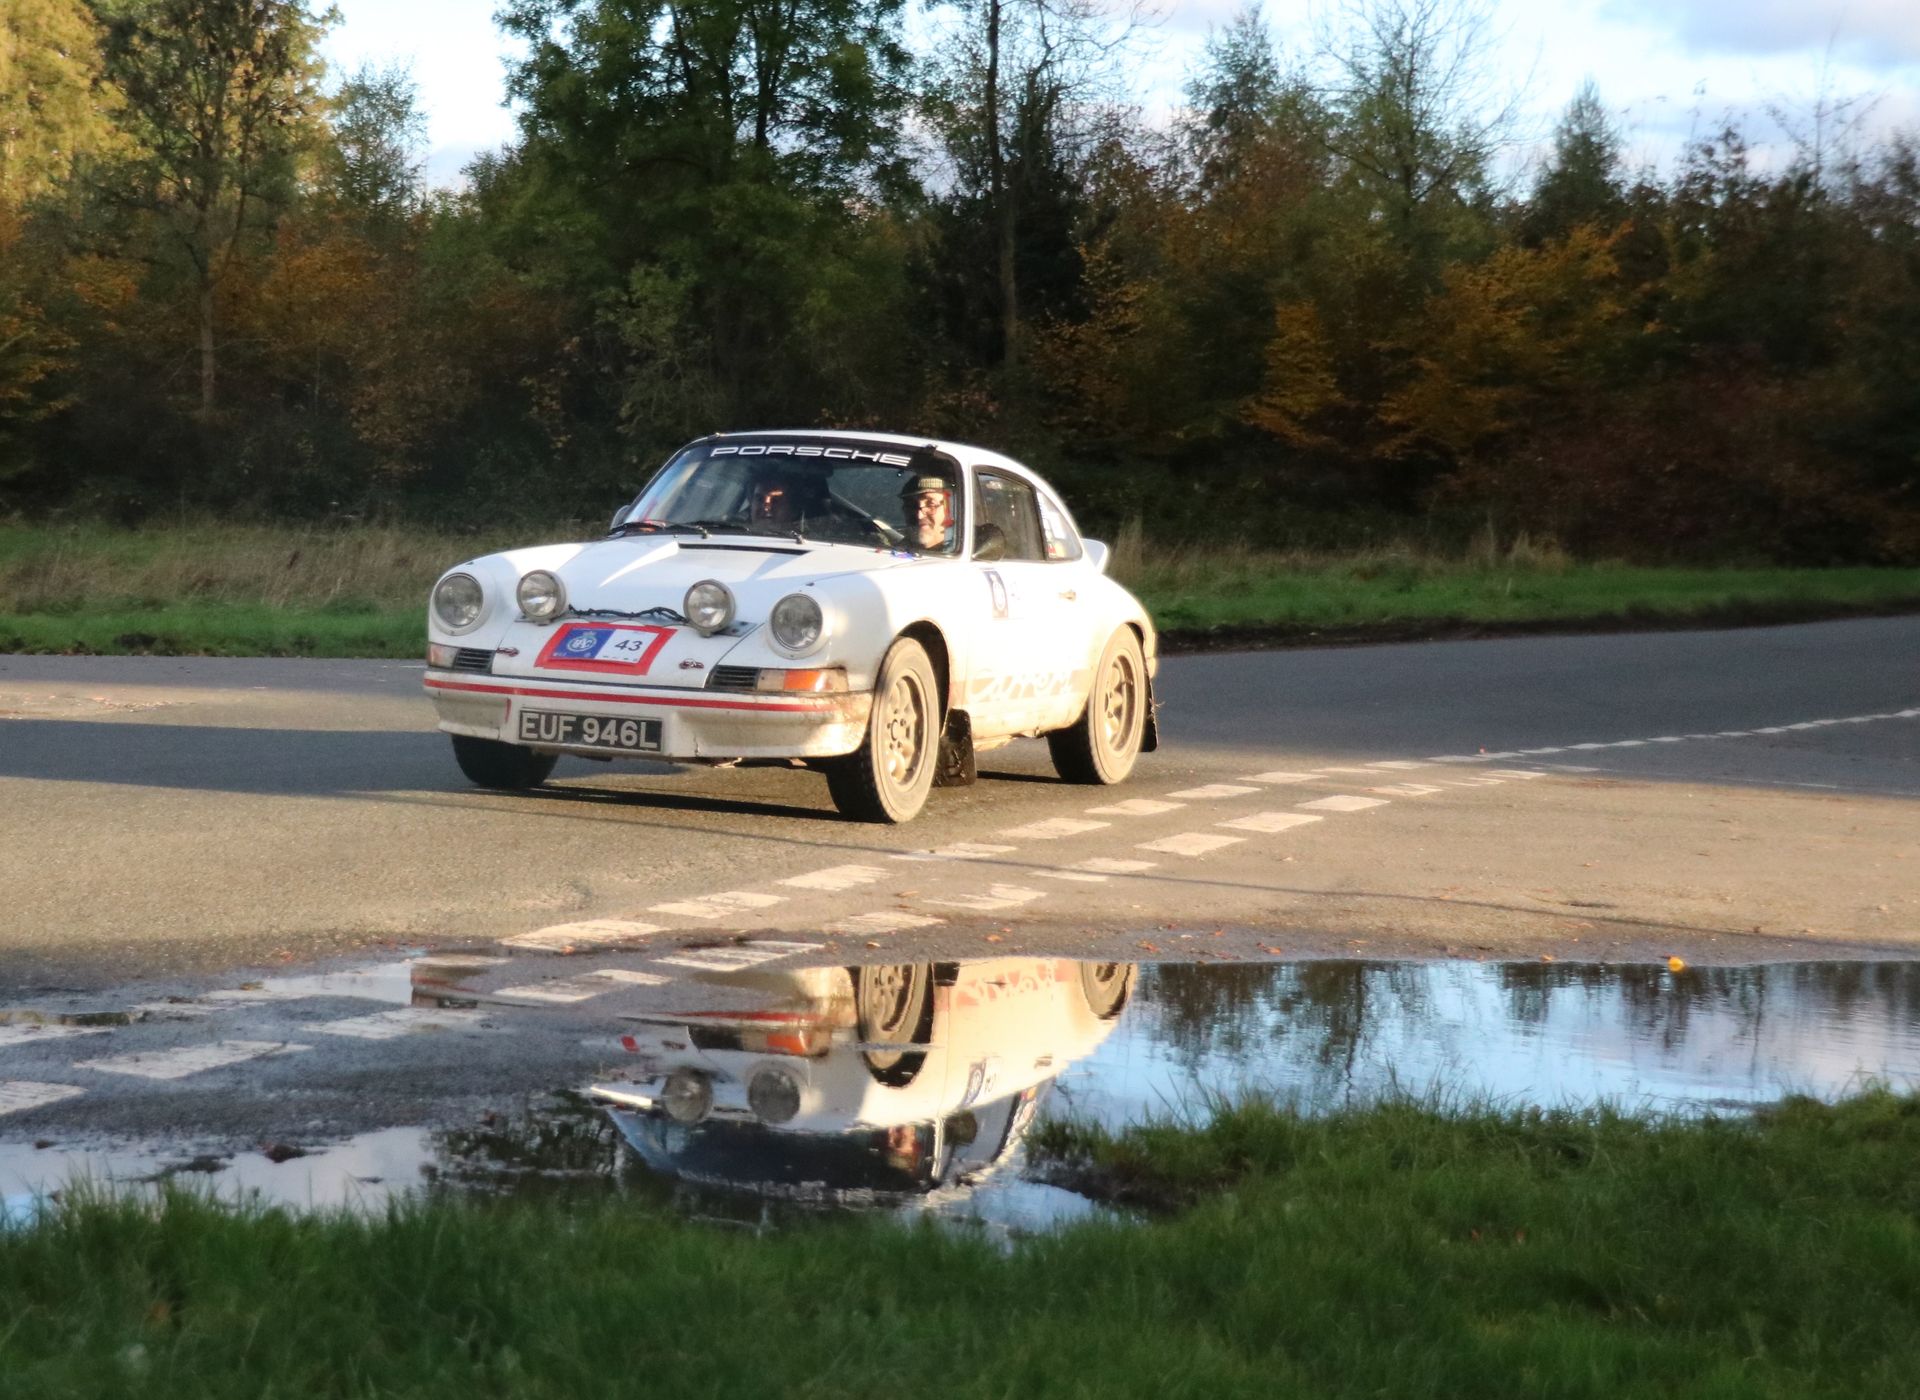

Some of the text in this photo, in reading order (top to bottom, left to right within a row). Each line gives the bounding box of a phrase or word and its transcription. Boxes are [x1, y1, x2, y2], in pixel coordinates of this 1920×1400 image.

[710, 446, 911, 467] PORSCHE
[615, 639, 643, 652] 43
[520, 712, 658, 749] EUF 946L
